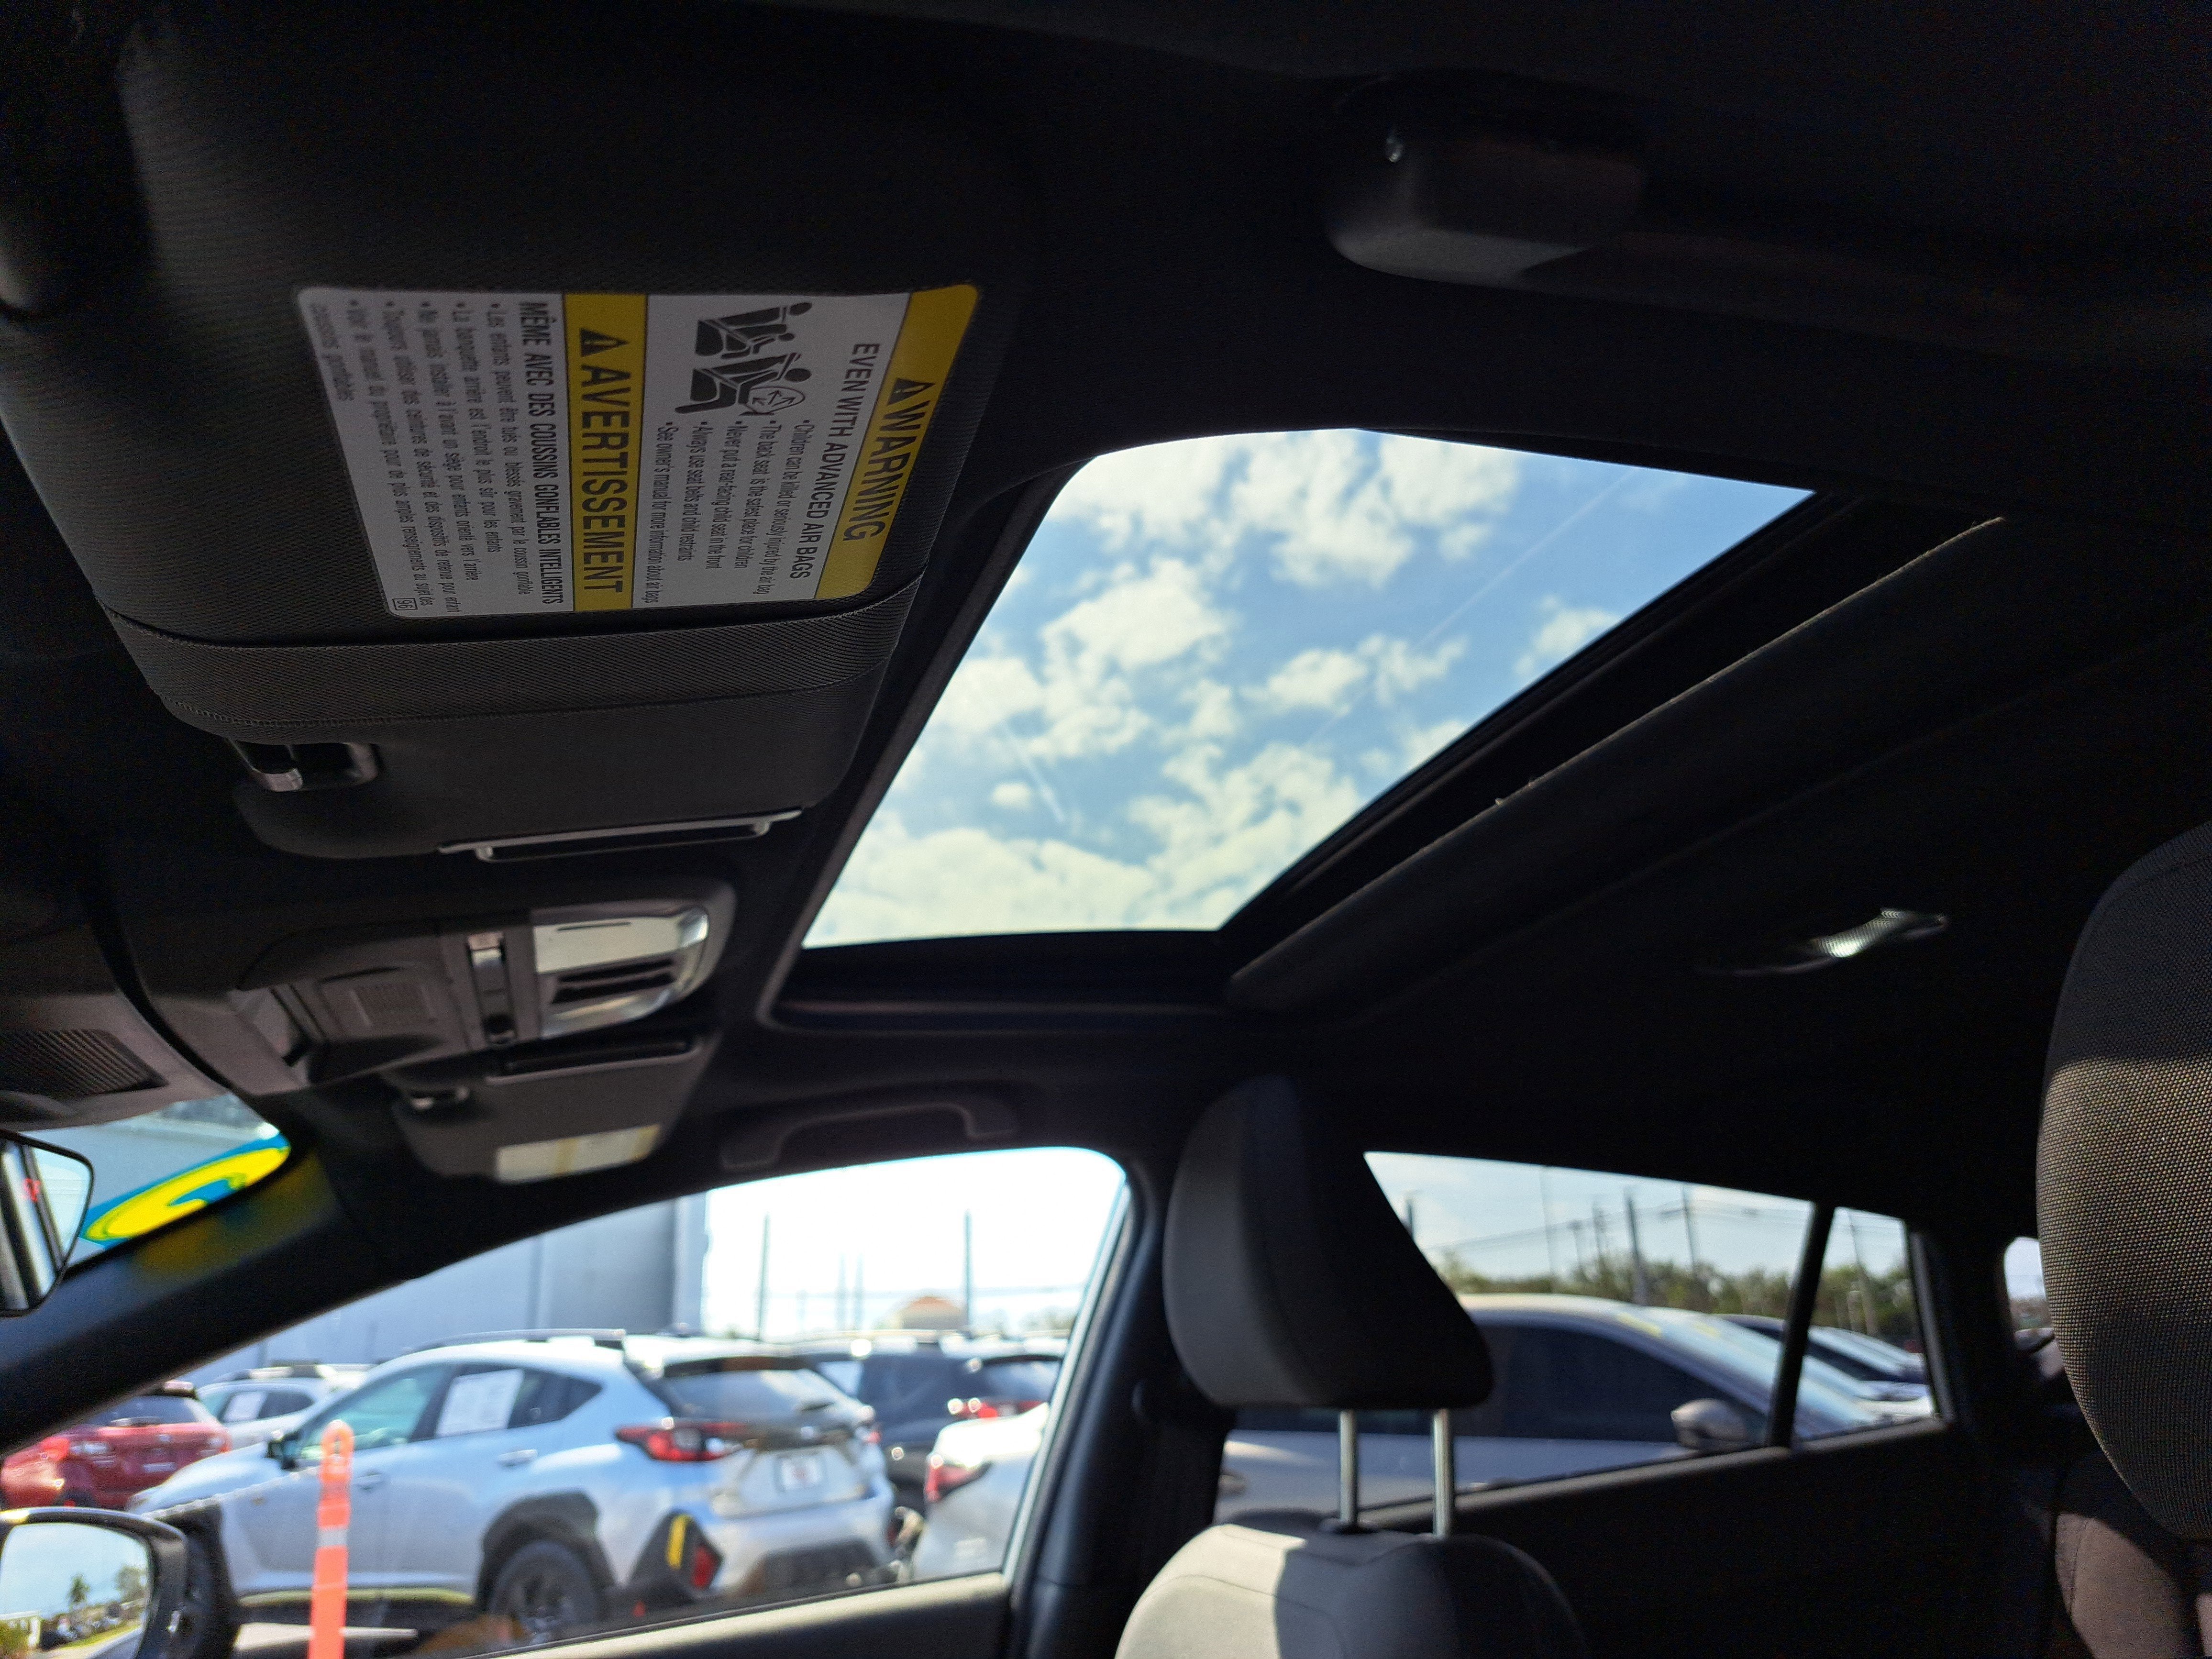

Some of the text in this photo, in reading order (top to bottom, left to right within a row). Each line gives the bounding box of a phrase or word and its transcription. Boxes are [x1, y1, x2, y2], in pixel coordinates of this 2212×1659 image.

[436, 409, 461, 436] l'avant
[467, 408, 488, 420] est
[498, 407, 519, 423] être
[405, 409, 428, 444] ceintures
[500, 426, 522, 443] tués
[656, 426, 679, 442] See
[758, 424, 782, 440] The
[442, 439, 459, 449] un
[470, 424, 493, 456] l'endroit
[724, 425, 749, 448] Never
[787, 424, 816, 455] Children
[379, 449, 401, 467] pour
[413, 448, 433, 458] de
[503, 446, 519, 456] ou
[518, 301, 564, 604] MÊME AVEC DES COUSSINS GONFLABLES INTELLIGENTS
[653, 442, 675, 473] owner's
[718, 449, 741, 462] put
[755, 441, 779, 459] back
[442, 452, 465, 471] siège
[752, 459, 772, 475] seat
[785, 457, 802, 470] can
[789, 343, 881, 579] EVEN WITH ADVANCED AIR BAGS
[387, 470, 408, 479] de
[415, 461, 440, 488] sécurité
[472, 469, 496, 484] plus
[504, 461, 525, 487] blessés
[580, 364, 631, 593] AVERTISSEMENT
[782, 471, 804, 480] be
[843, 399, 924, 541] WARNING
[387, 482, 411, 497] plus
[443, 475, 465, 491] pour
[652, 474, 673, 500] manual
[710, 469, 738, 506] rear-facing
[747, 486, 768, 497] the
[777, 480, 801, 499] killed
[478, 487, 498, 498] sûr
[676, 426, 714, 561] Always use seat belts and child restraints
[393, 499, 417, 523] amples
[424, 501, 443, 513] des
[451, 493, 471, 517] enfants
[477, 501, 496, 517] pour
[503, 490, 527, 524] gravement
[651, 500, 672, 511] for
[743, 498, 764, 518] safest
[649, 512, 666, 530] more
[712, 507, 733, 522] child
[764, 508, 791, 536] seriously
[424, 516, 450, 547] dispositifs
[455, 520, 477, 541] orienté
[483, 519, 501, 529] les
[508, 526, 525, 536] par
[710, 523, 728, 537] seat
[738, 518, 761, 535] place
[400, 525, 427, 571] renseignements
[484, 531, 503, 553] enfants
[647, 530, 669, 564] information
[738, 535, 758, 544] for
[762, 536, 786, 557] injured
[434, 549, 452, 557] de
[460, 543, 475, 556] vers
[707, 544, 727, 554] the
[733, 545, 755, 569] children
[513, 547, 532, 569] coussin
[705, 554, 726, 569] front
[436, 559, 453, 580] retenue
[462, 558, 482, 581] l'arrière
[645, 564, 665, 582] about
[760, 566, 779, 575] the
[412, 582, 434, 596] sujet
[437, 582, 456, 594] pour
[512, 571, 534, 595] gonflable
[752, 584, 774, 594] bag
[395, 599, 414, 609] 96
[418, 596, 436, 606] des
[443, 597, 462, 613] enfant
[641, 590, 663, 603] bags
